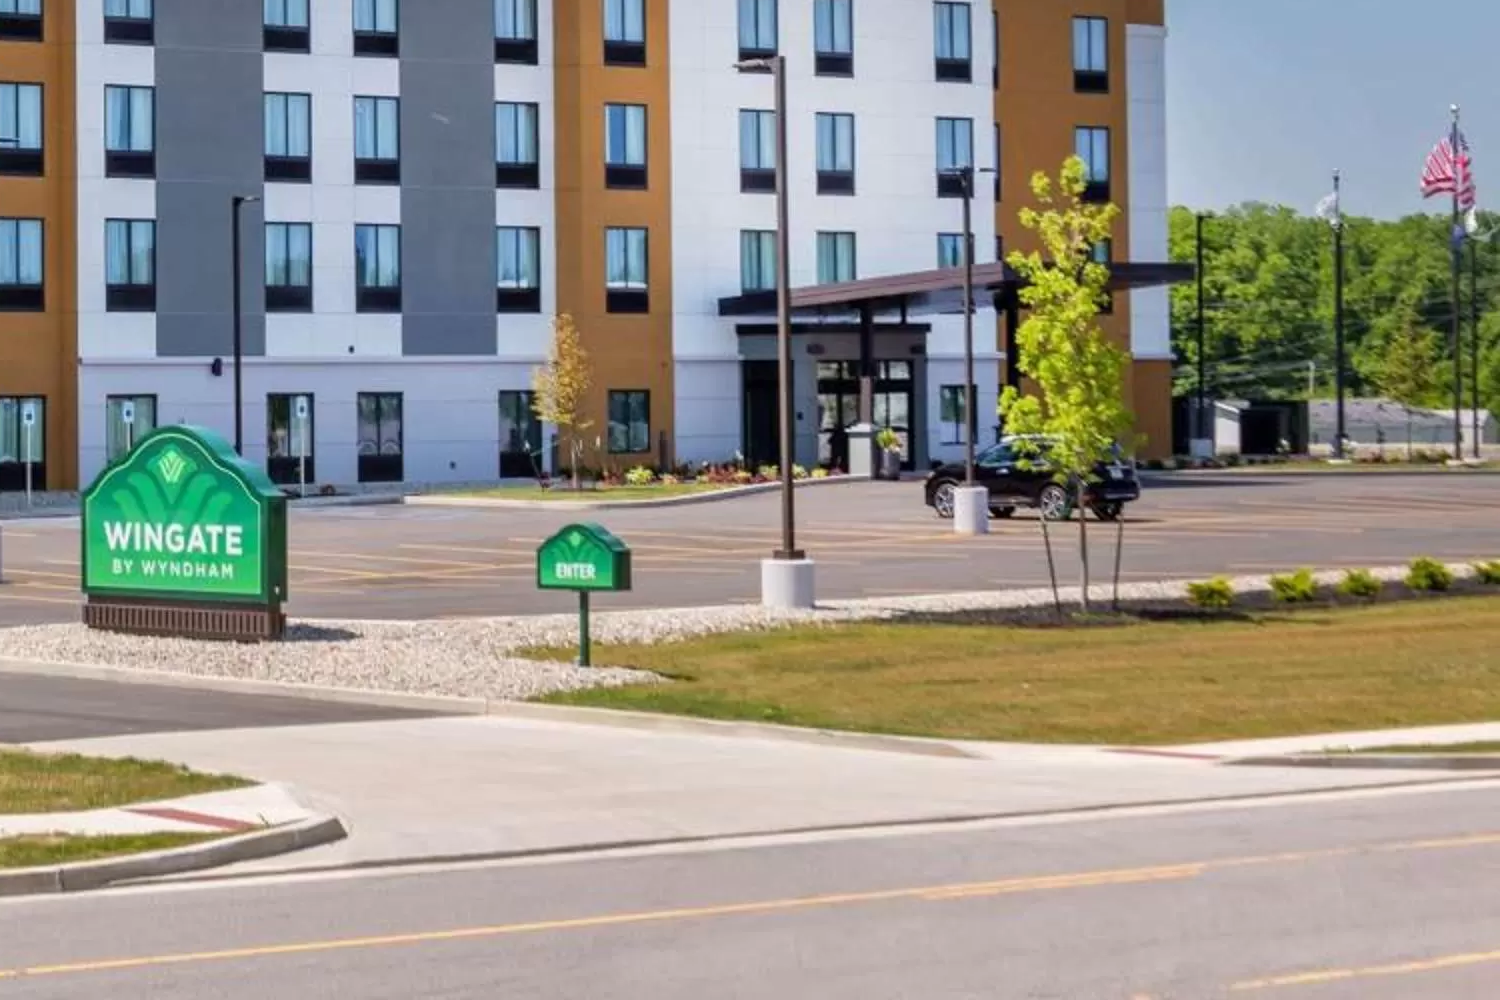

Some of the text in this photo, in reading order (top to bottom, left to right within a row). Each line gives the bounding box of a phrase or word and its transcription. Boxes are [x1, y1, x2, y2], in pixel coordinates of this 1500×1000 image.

[103, 520, 243, 556] WINGATE
[112, 558, 234, 579] BY WYNDHAM
